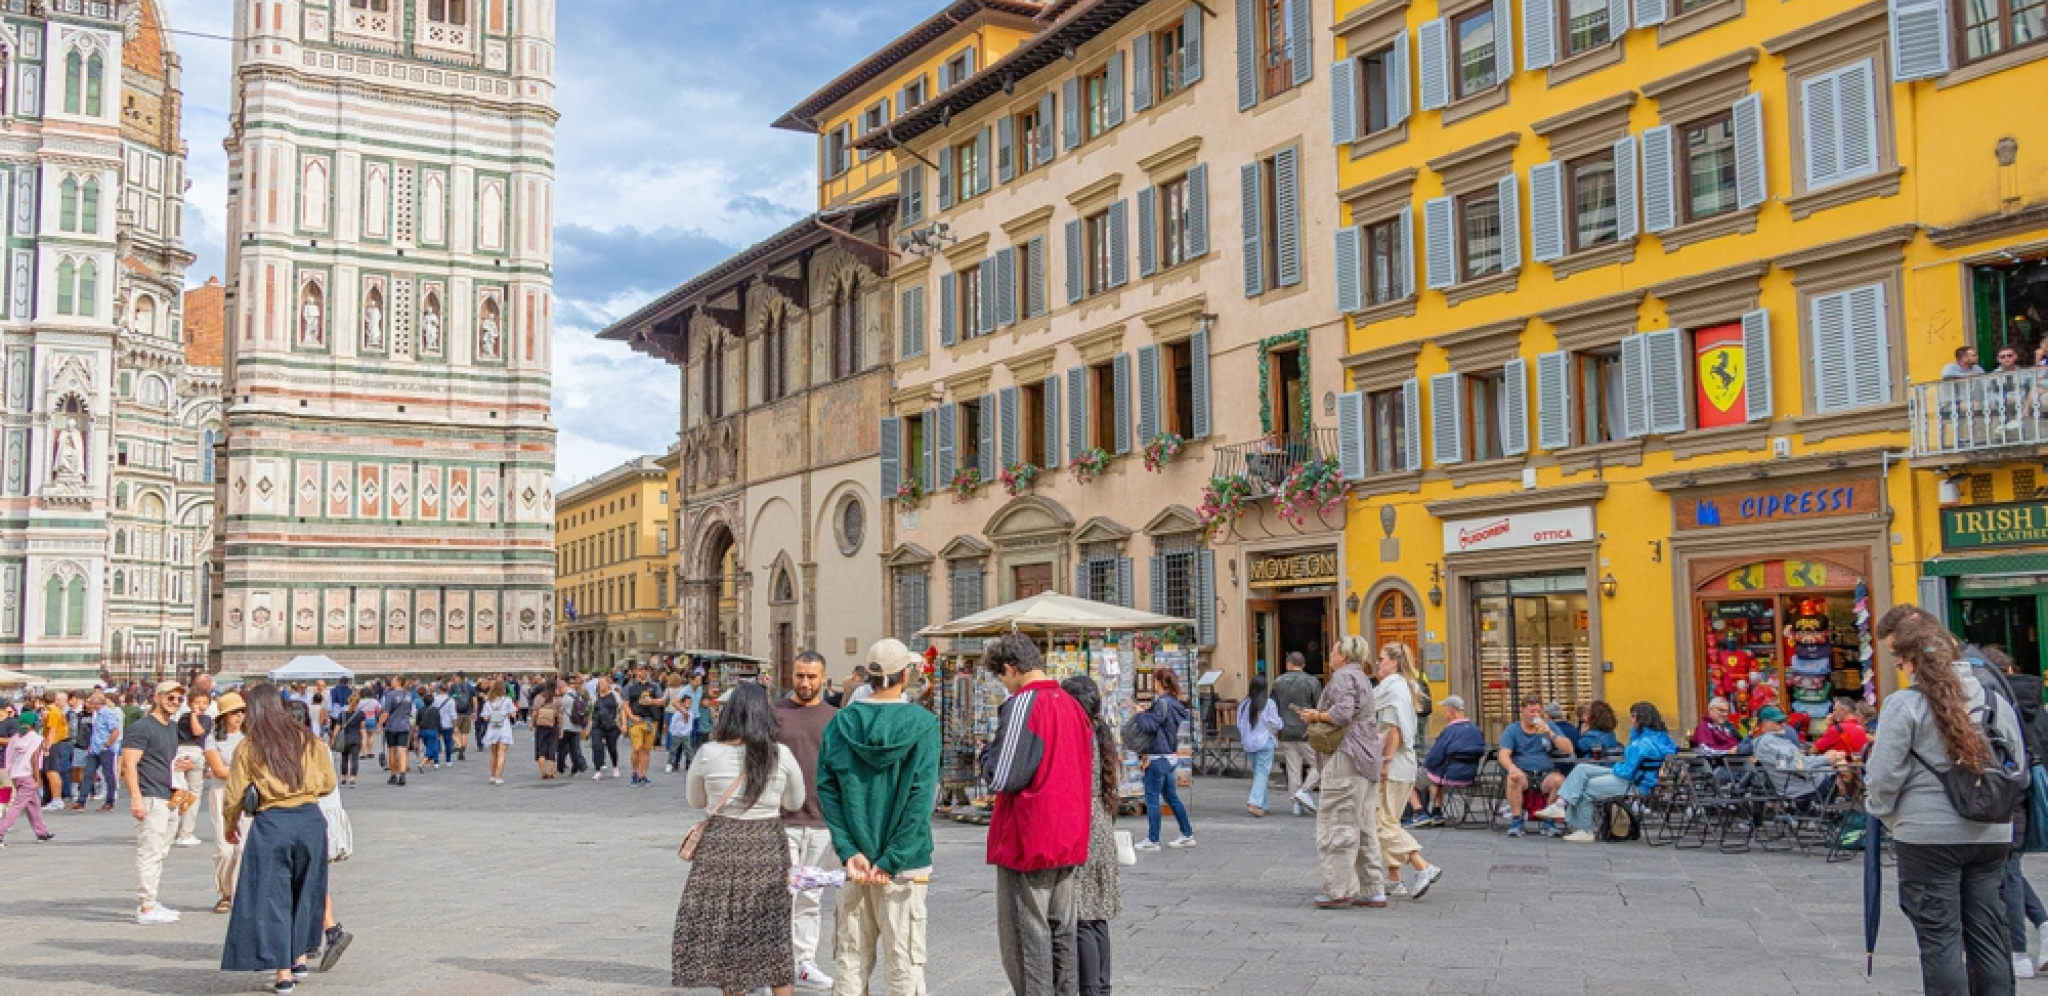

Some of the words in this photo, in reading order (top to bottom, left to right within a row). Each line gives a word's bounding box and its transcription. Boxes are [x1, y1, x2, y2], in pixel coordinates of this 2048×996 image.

[1740, 487, 1853, 518] CIPRESSI
[1954, 507, 2034, 534] IRISH
[1533, 529, 1573, 541] OTTICA
[1250, 556, 1302, 579] MOVE
[1306, 553, 1336, 576] ON
